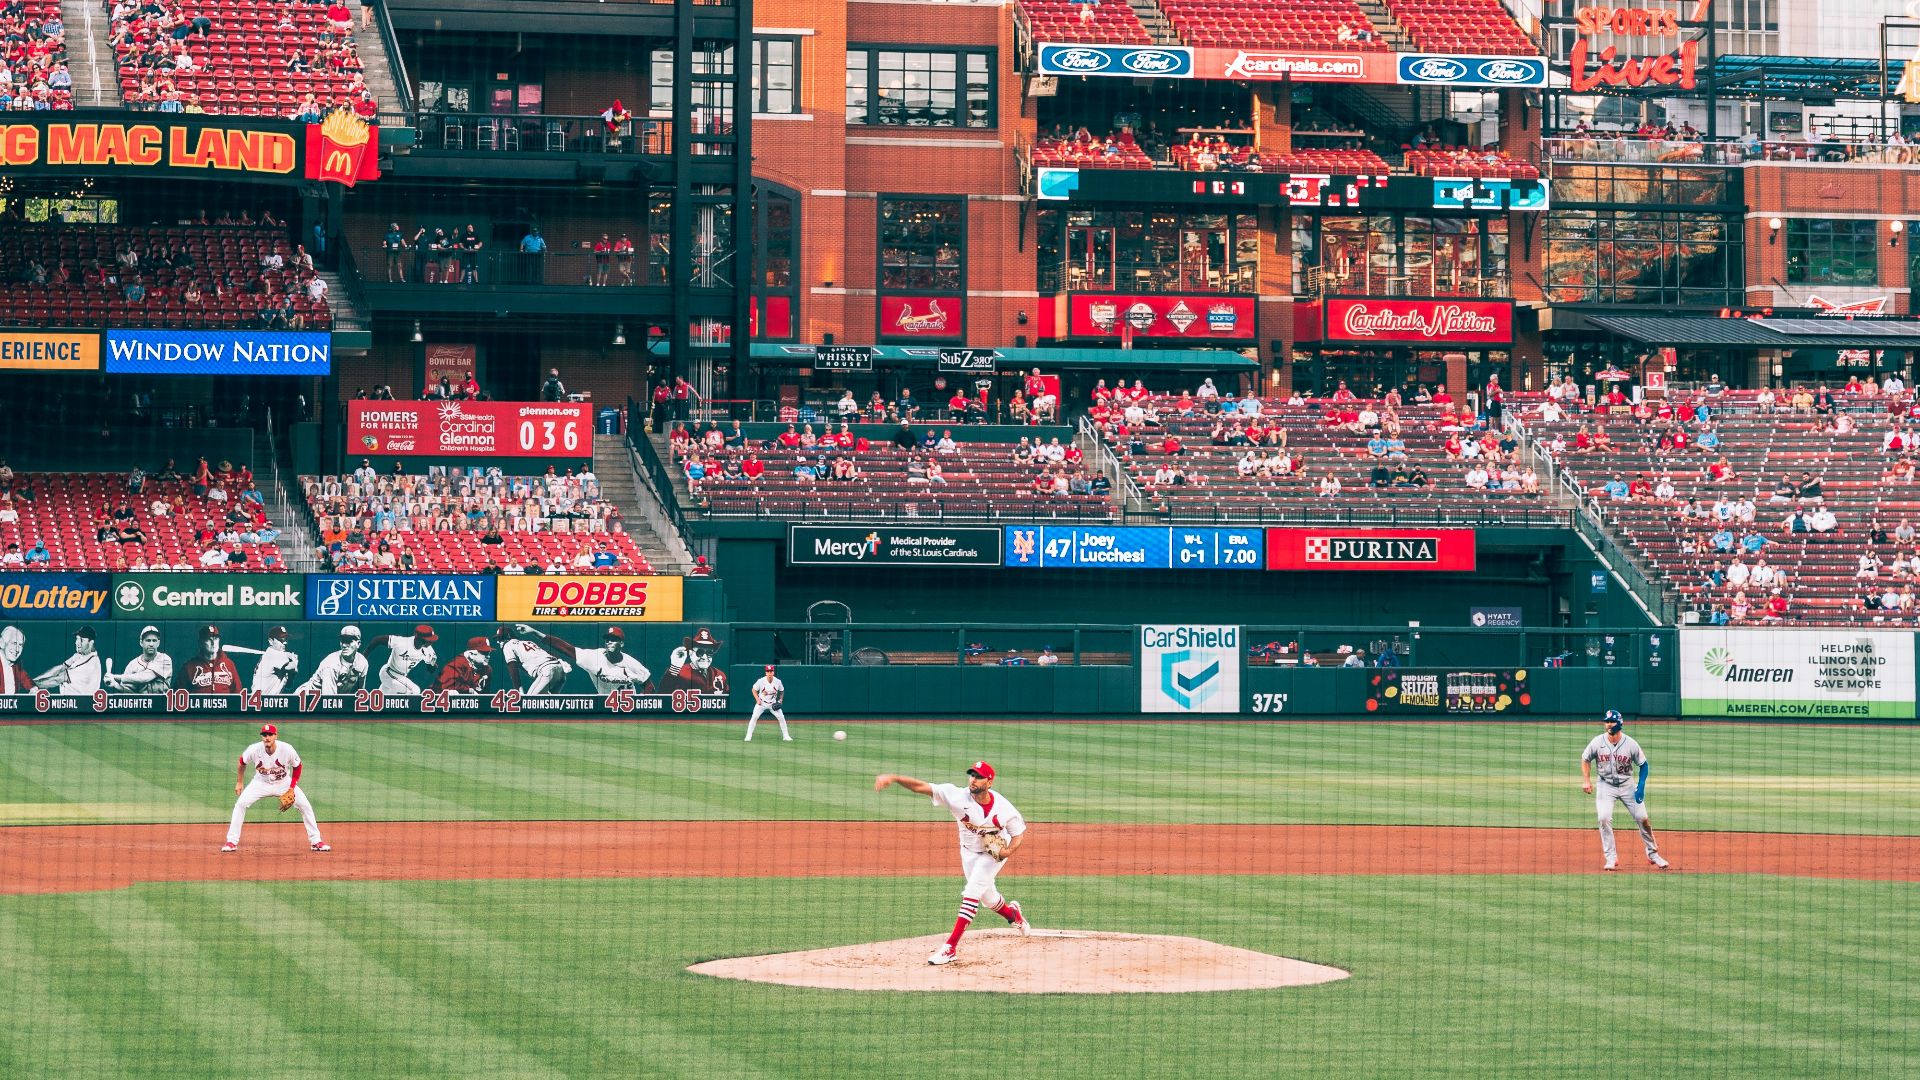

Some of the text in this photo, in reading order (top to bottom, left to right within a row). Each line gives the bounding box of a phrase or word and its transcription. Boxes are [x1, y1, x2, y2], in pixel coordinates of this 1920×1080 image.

[1577, 6, 1679, 37] SPORTS
[1062, 50, 1100, 68] Ford
[1132, 52, 1170, 70] Ford
[1245, 56, 1358, 74] cardinals.com
[1570, 38, 1699, 93] Live!
[1419, 59, 1458, 78] Ford
[1488, 61, 1526, 80] Ford
[48, 124, 162, 165] MAC
[170, 126, 296, 174] LAND
[1344, 303, 1496, 336] Cardinals Nation
[429, 357, 472, 366] BOWTIE BAR
[817, 352, 870, 361] WHISKEY
[1653, 374, 1660, 387] 5
[361, 411, 418, 422] HOMERS
[519, 406, 580, 417] glennon.org
[382, 422, 418, 430] HEALTH
[440, 421, 495, 433] Cardinal
[440, 432, 495, 445] Glennon
[815, 538, 867, 559] Mercy
[890, 537, 957, 547] Medical Provider
[1045, 538, 1071, 558] 47
[1080, 533, 1115, 548] Joey
[1185, 535, 1202, 544] W-L
[1228, 535, 1249, 545] ERA
[890, 548, 899, 557] of
[899, 548, 912, 557] the
[943, 549, 978, 558] Cardinals
[1080, 548, 1145, 563] Lucchesi
[1180, 550, 1205, 563] 0-1
[1224, 550, 1257, 563] 7.00
[1333, 541, 1433, 559] PURINA
[0, 584, 108, 614] OLottery
[152, 585, 301, 606] Central Bank
[357, 579, 483, 601] SITEMAN
[536, 582, 648, 605] DOBBS
[357, 603, 482, 617] CANCER CENTER
[534, 607, 644, 616] TIRE & AUTO CENTERS
[1143, 626, 1236, 648] CarShield
[1821, 644, 1873, 653] HELPING
[1808, 656, 1886, 665] ILLINOIS AND
[1725, 664, 1794, 683] Ameren
[1819, 667, 1876, 676] MISSOURI
[1401, 682, 1438, 695] SELTZER
[1814, 679, 1882, 689] SAVE MORE
[35, 689, 78, 712] 6 MUSIAL
[93, 689, 153, 712] 9 SLAUGHTER
[166, 688, 228, 712] 10 LA RUSSA
[240, 688, 289, 711] 14 BOYER
[299, 688, 343, 712] 17 DEAN
[355, 688, 409, 711] 20 BROCK
[420, 688, 479, 712] 24 HERZOG
[490, 688, 594, 712] 42 ROBINSON/SUTTER
[604, 688, 663, 712] 45 GIBSON
[672, 689, 727, 712] 85 BUSCH
[1252, 693, 1288, 713] 375'
[1400, 694, 1438, 706] LEMONADE
[1726, 703, 1869, 715] AMEREN.COM/REBATES
[1618, 765, 1630, 775] 20
